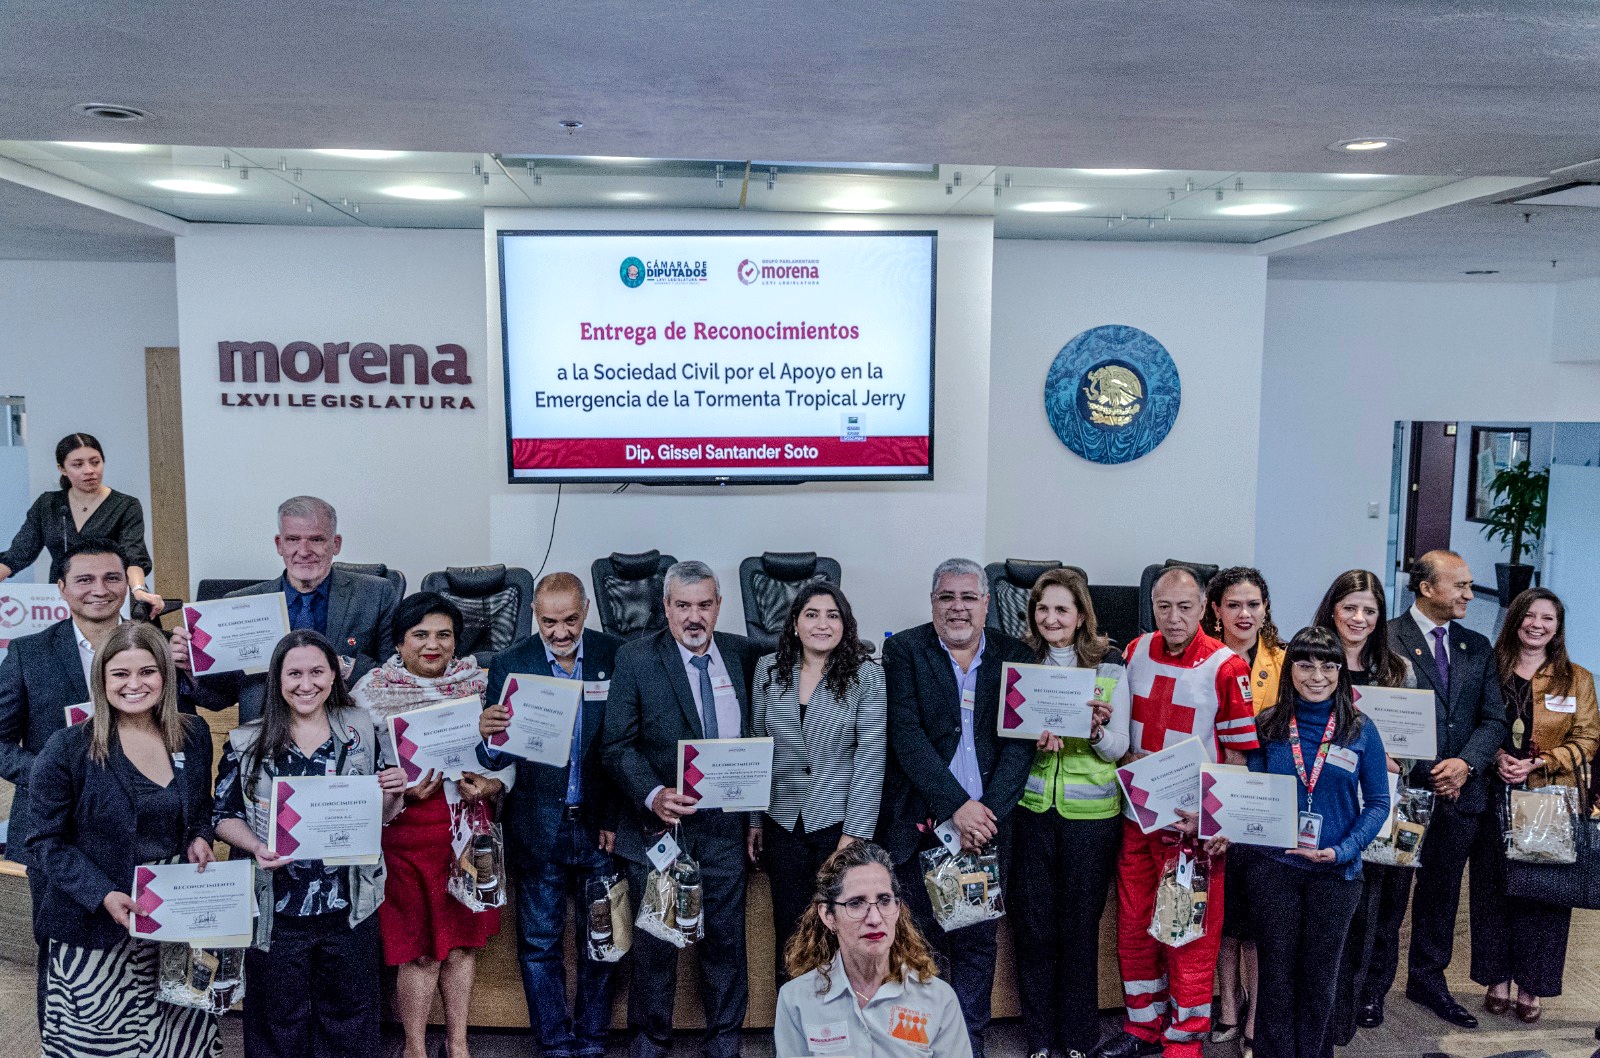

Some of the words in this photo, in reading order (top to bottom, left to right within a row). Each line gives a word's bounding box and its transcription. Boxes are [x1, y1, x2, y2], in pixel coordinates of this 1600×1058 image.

[646, 260, 690, 269] CÁMARA
[695, 261, 707, 269] DE
[646, 268, 707, 278] DIPUTADOS
[761, 265, 820, 279] morena
[580, 322, 657, 346] Entrega
[664, 321, 687, 340] de
[693, 321, 860, 340] Reconocimientos
[217, 340, 473, 386] morena
[557, 367, 568, 381] a
[573, 363, 589, 380] la
[593, 362, 677, 381] Sociedad
[681, 362, 720, 380] Civil
[725, 366, 754, 384] por
[759, 362, 776, 380] el
[780, 362, 836, 384] Apoyo
[841, 366, 863, 380] en
[867, 362, 883, 380] la
[221, 392, 280, 407] LXVI
[288, 393, 476, 410] LEGISLATURA
[535, 390, 642, 413] Emergencia
[646, 390, 669, 408] de
[674, 390, 690, 407] la
[694, 389, 781, 407] Tormenta
[785, 389, 858, 411] Tropical
[862, 389, 906, 411] Jerry
[625, 444, 655, 464] Dip.
[658, 444, 702, 461] Gissel
[705, 443, 781, 460] Santander
[784, 443, 819, 460] Soto
[310, 800, 367, 808] RECONOCIMIENTO
[173, 881, 236, 891] RECONOCIMIENTO
